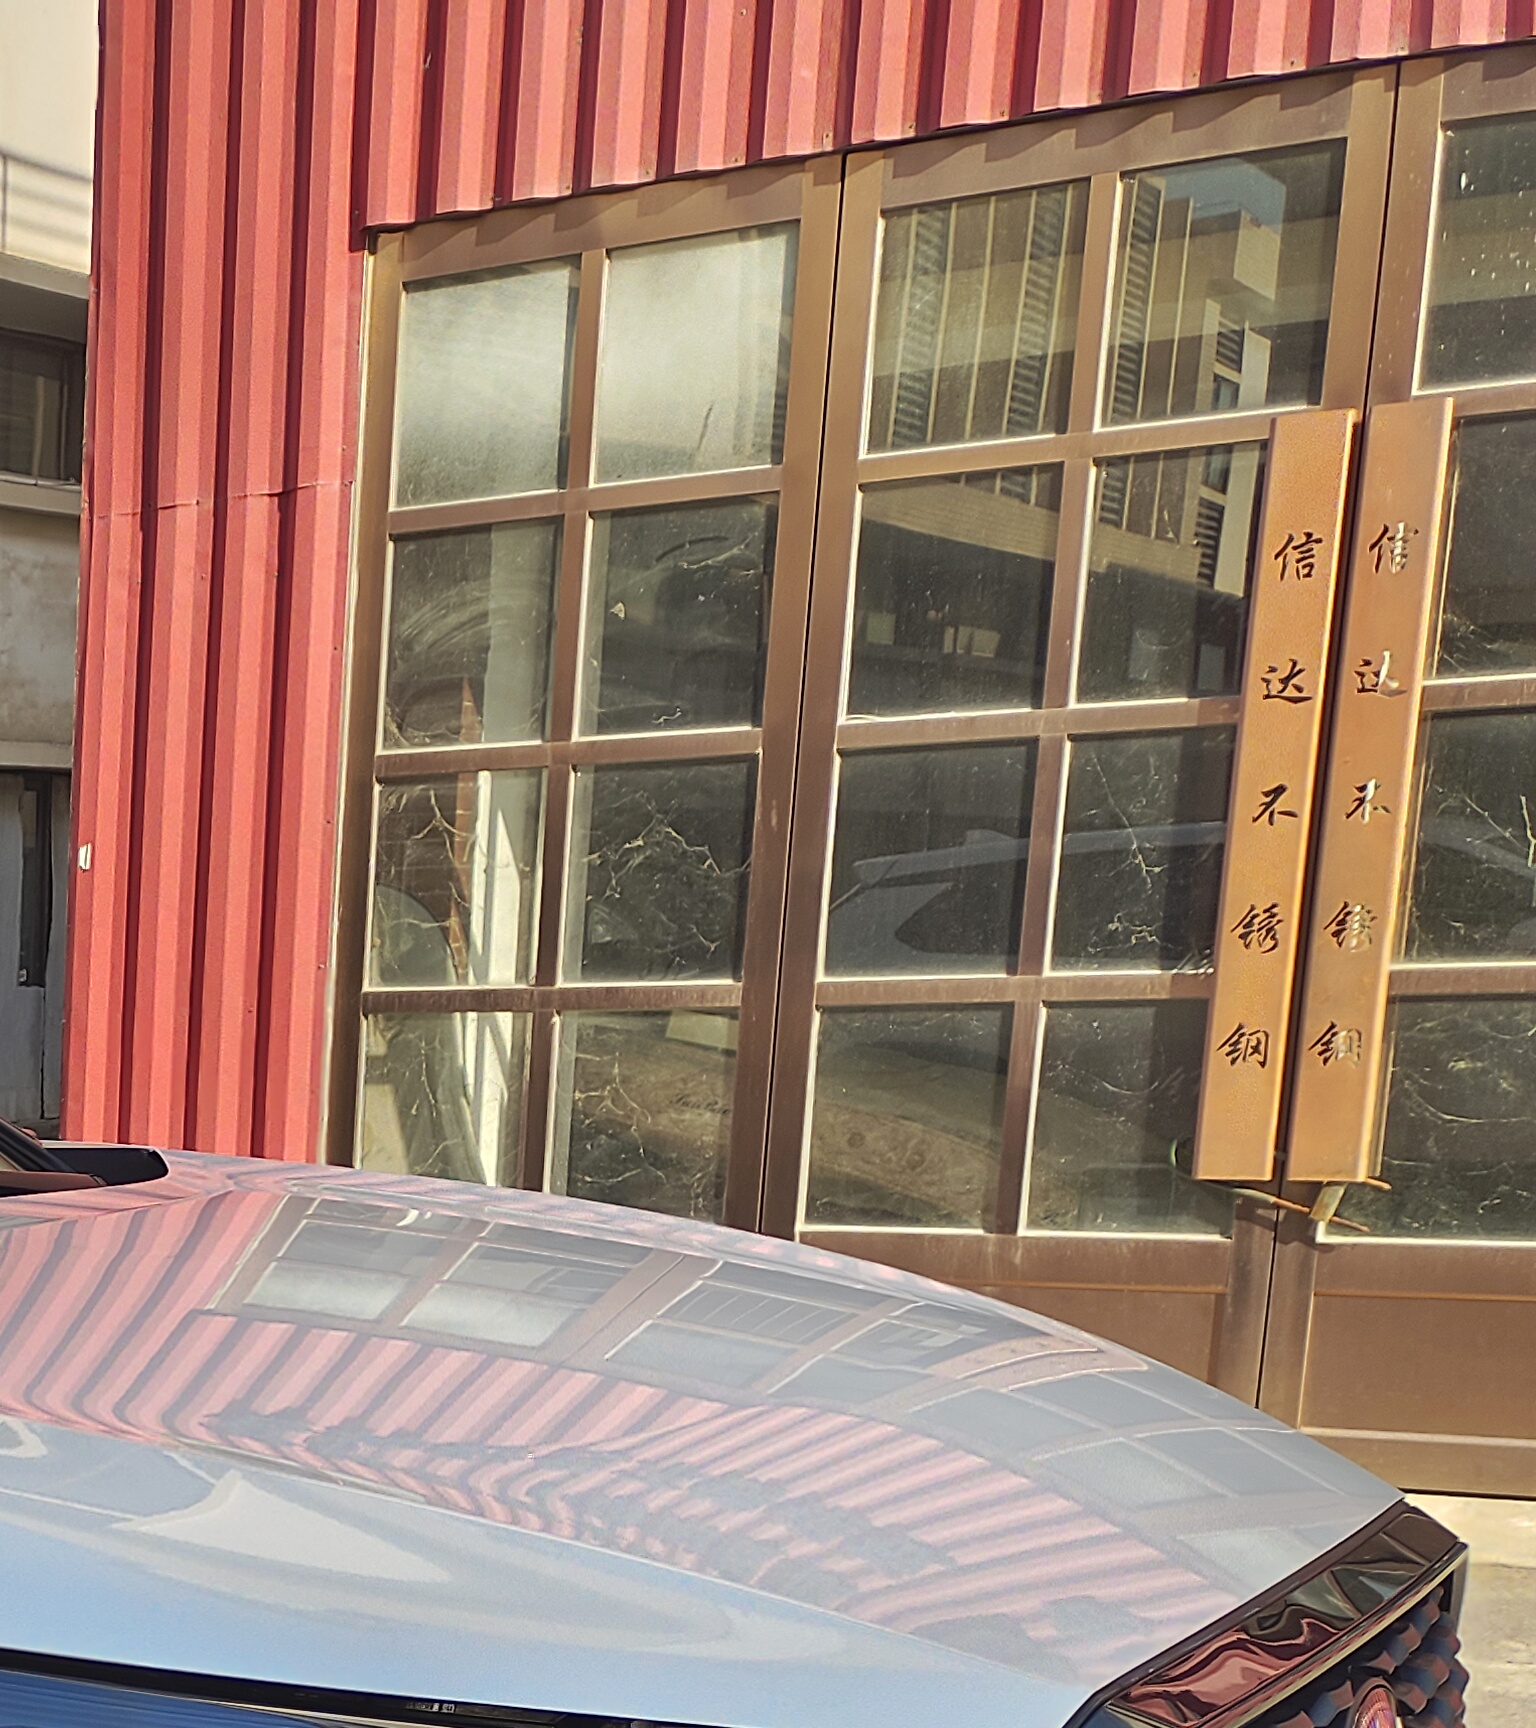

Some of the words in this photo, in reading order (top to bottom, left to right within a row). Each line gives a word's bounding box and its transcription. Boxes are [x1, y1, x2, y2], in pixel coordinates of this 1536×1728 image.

[1216, 531, 1324, 1069] 信达不锈钢
